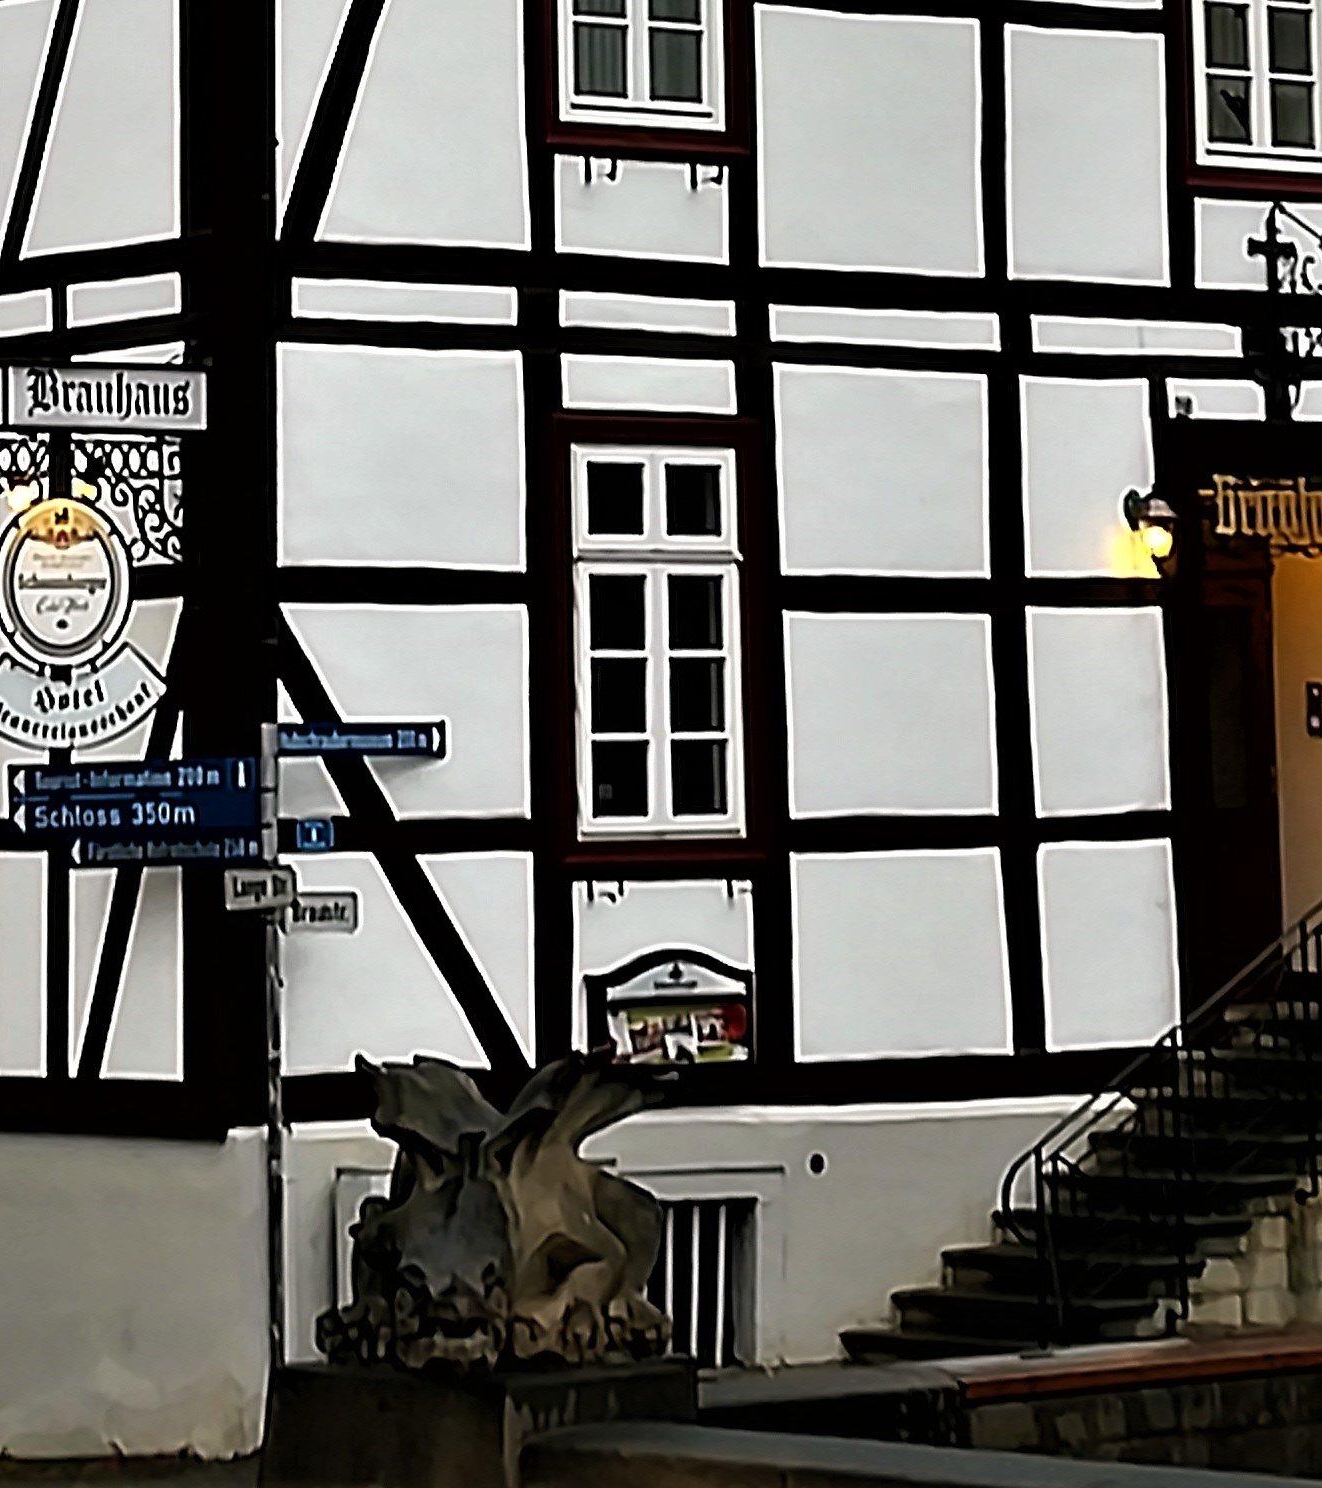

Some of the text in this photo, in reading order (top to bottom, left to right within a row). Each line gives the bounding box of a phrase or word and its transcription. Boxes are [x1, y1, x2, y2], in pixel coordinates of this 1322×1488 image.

[27, 368, 190, 421] Brauhaus
[35, 680, 105, 713] Hotel
[35, 803, 121, 829] Schloss
